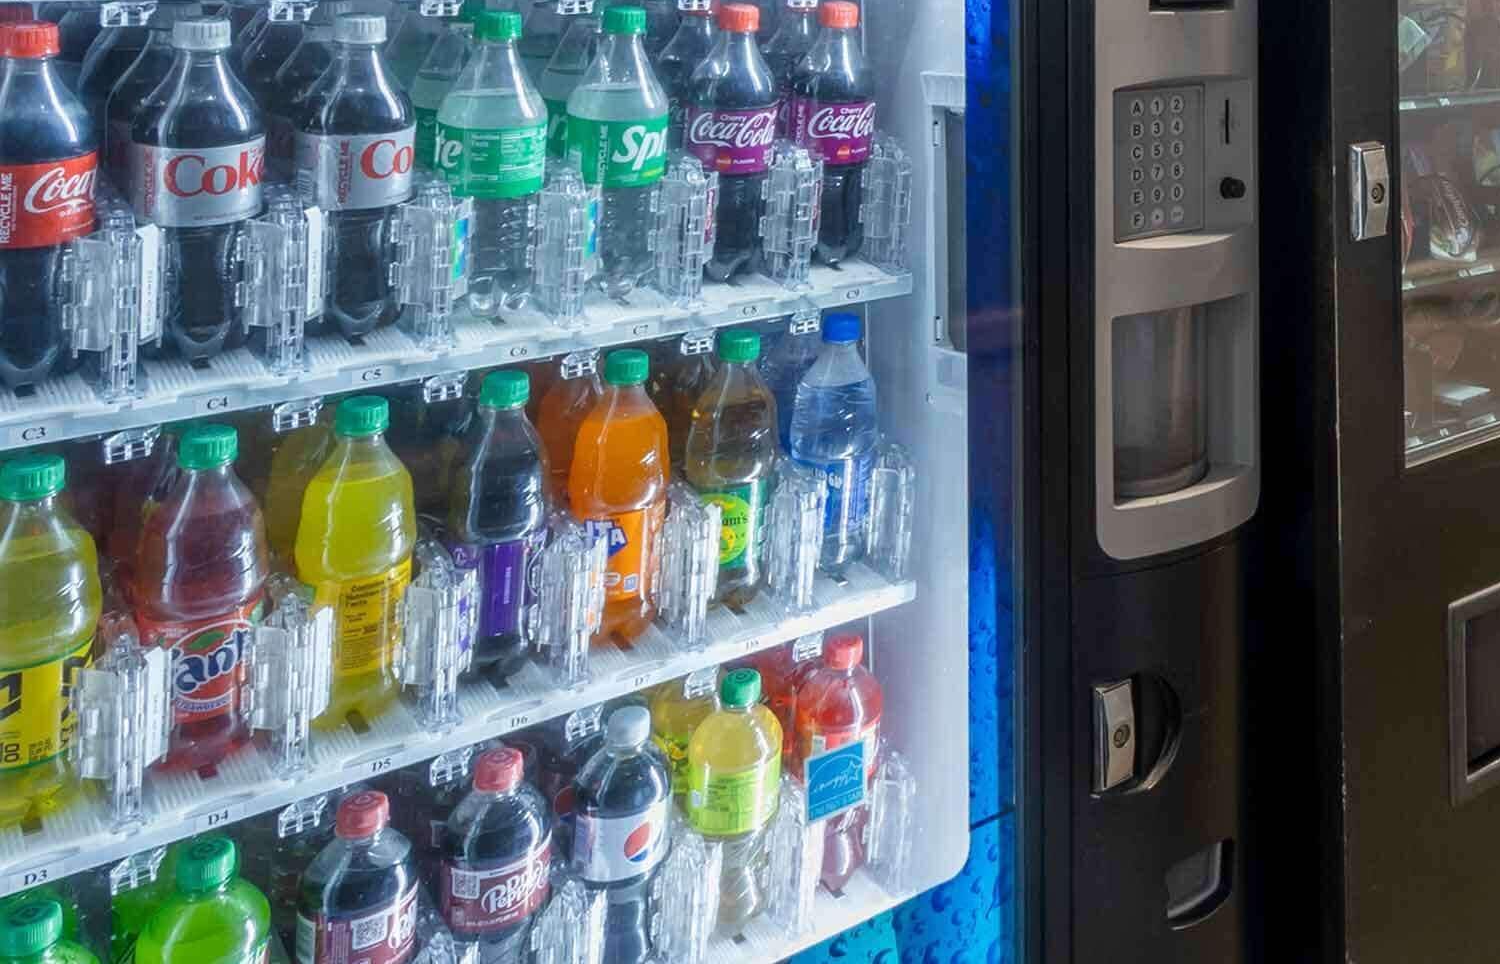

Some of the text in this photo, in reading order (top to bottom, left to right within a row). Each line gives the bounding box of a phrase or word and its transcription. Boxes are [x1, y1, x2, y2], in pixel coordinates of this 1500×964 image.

[1132, 98, 1180, 114] A 1 2
[1133, 121, 1180, 136] B 3 4
[1132, 143, 1180, 158] C 5 6
[1132, 164, 1180, 181] D 7 8
[1133, 186, 1180, 204] E 9 0
[1133, 214, 1140, 226] F
[846, 289, 860, 300] C9
[742, 305, 758, 317] C8
[633, 324, 649, 336] C7
[510, 345, 527, 357] C6
[362, 368, 382, 381] C5
[207, 396, 228, 410] C4
[22, 426, 47, 441] C3
[635, 674, 651, 687] D7
[511, 715, 528, 728] D6
[371, 757, 392, 771] D5
[207, 809, 229, 825] D4
[24, 869, 48, 886] D3
